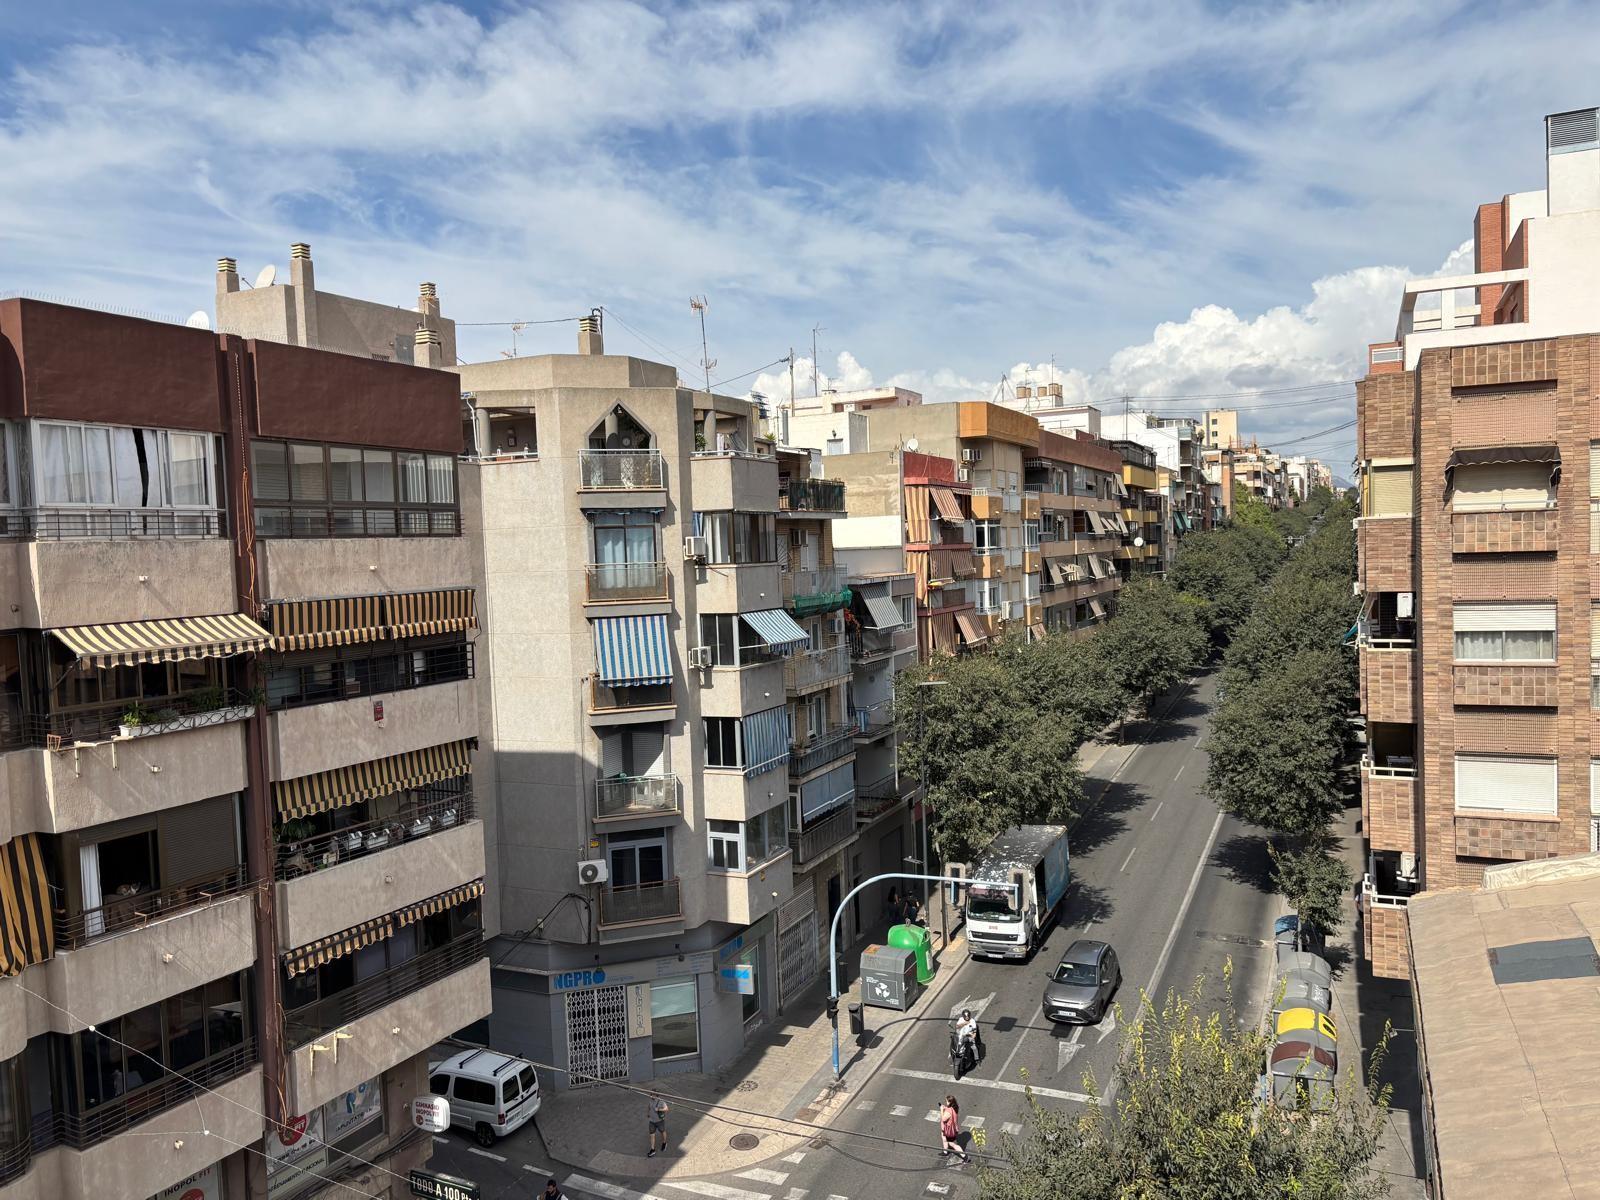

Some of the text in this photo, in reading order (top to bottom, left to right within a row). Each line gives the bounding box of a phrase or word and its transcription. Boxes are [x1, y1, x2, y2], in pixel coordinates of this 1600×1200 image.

[199, 1168, 210, 1178] FIT
[435, 1183, 442, 1197] A
[444, 1186, 460, 1200] 100
